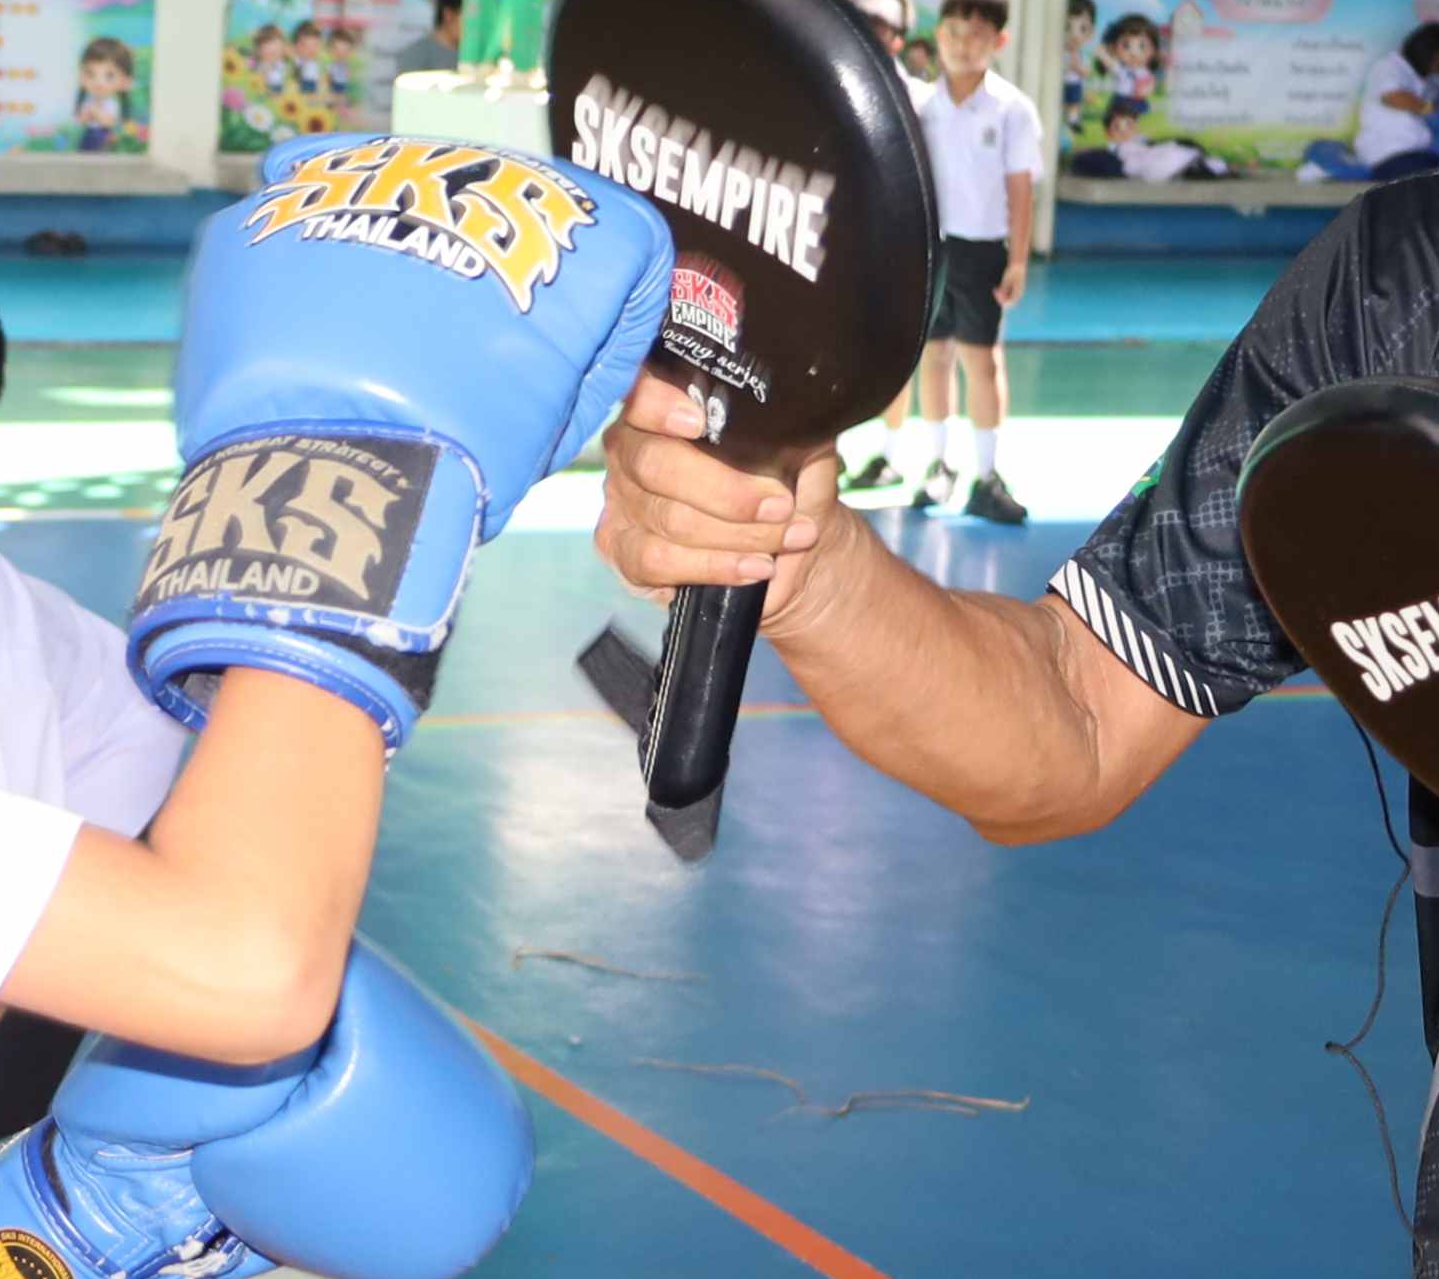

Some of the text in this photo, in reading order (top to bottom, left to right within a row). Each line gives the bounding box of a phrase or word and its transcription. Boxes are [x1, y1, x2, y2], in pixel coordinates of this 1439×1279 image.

[571, 92, 830, 284] SKSEMPIRE
[245, 140, 598, 314] SKS
[301, 214, 488, 280] THAILAND
[661, 326, 717, 360] oxing
[670, 301, 739, 354] EMPIRE
[294, 437, 399, 477] STRATEGY
[137, 450, 402, 602] SKS
[157, 557, 321, 601] THAILAND
